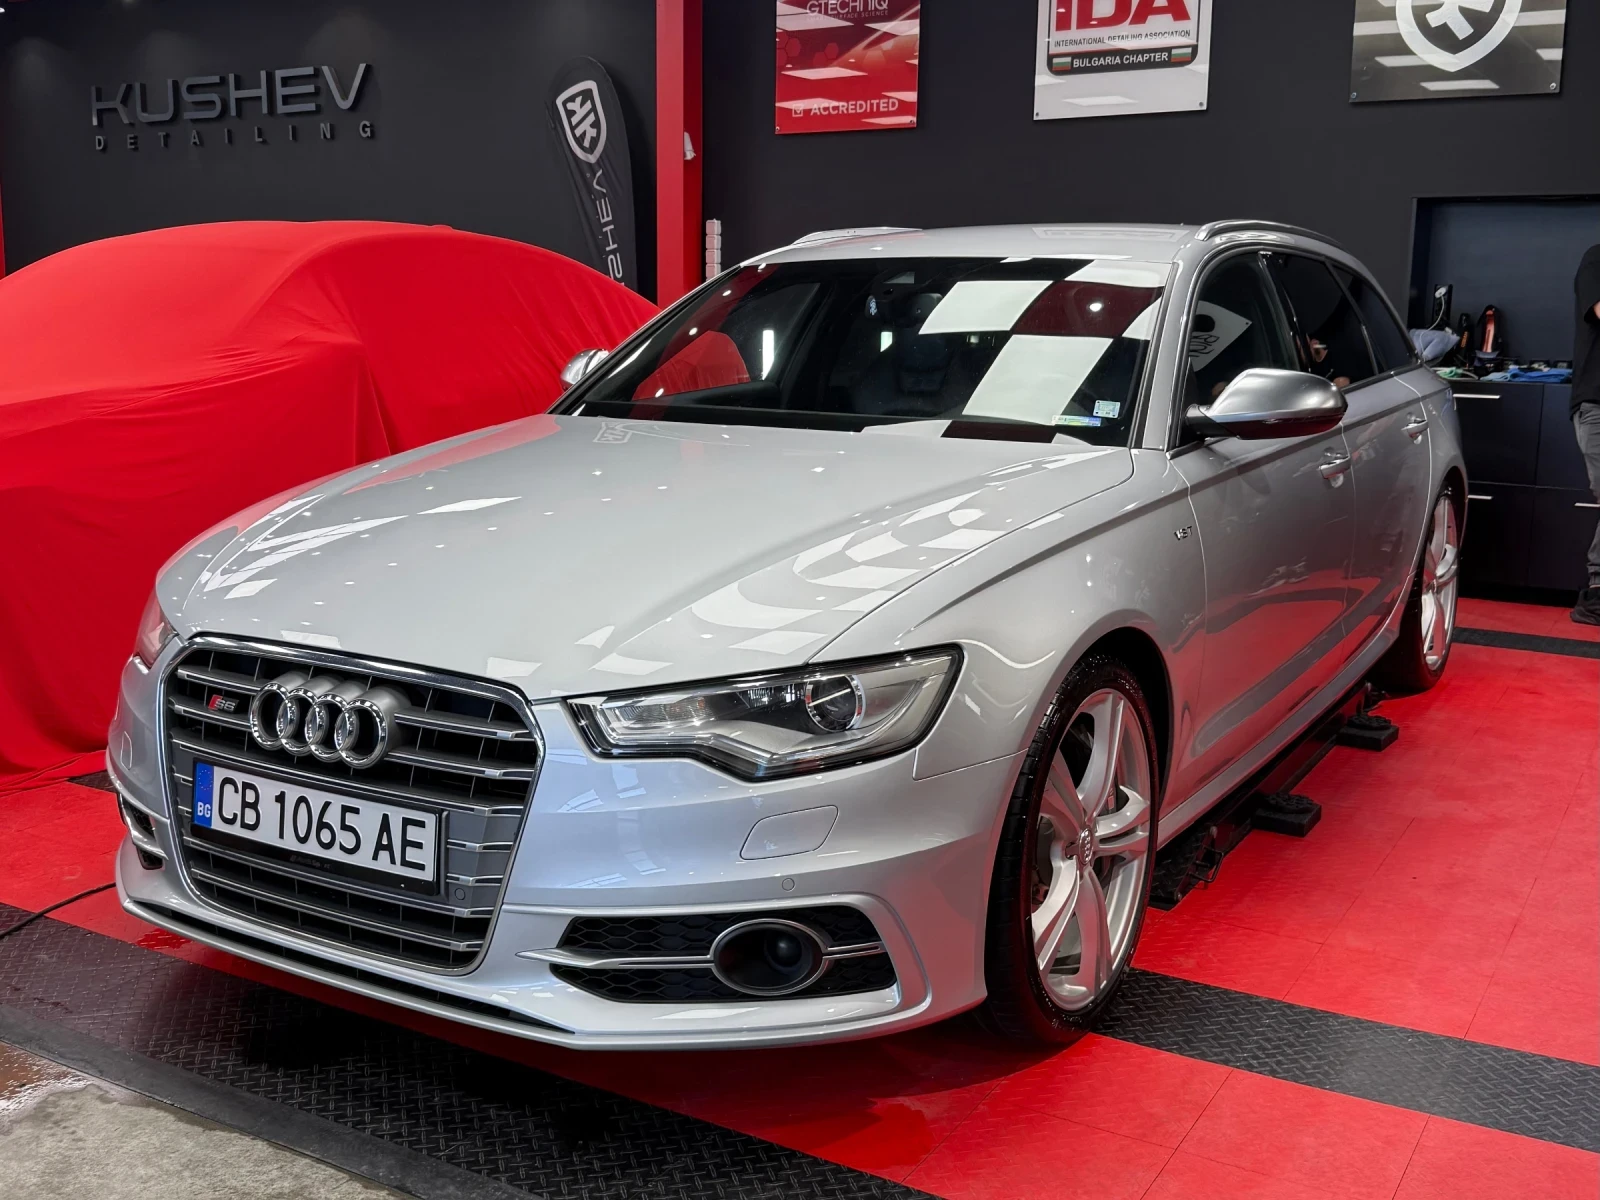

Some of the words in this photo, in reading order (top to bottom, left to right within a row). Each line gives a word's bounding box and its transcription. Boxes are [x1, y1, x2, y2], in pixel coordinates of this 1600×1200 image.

[806, 0, 889, 16] GTECHNIQ
[861, 10, 889, 18] SCIENCE
[1055, 0, 1191, 32] IDA
[1054, 36, 1105, 48] INTERNATIONAL
[1144, 29, 1191, 40] ASSOCIATION
[1073, 56, 1121, 68] BULGARIA
[1123, 52, 1169, 64] CHAPTER
[90, 63, 368, 126] KUSHEV
[810, 98, 899, 116] ACCREDITED
[95, 120, 372, 150] DETAILING
[197, 801, 212, 818] BG
[218, 776, 262, 832] CB
[274, 790, 362, 855] 1065
[372, 813, 426, 872] AE
